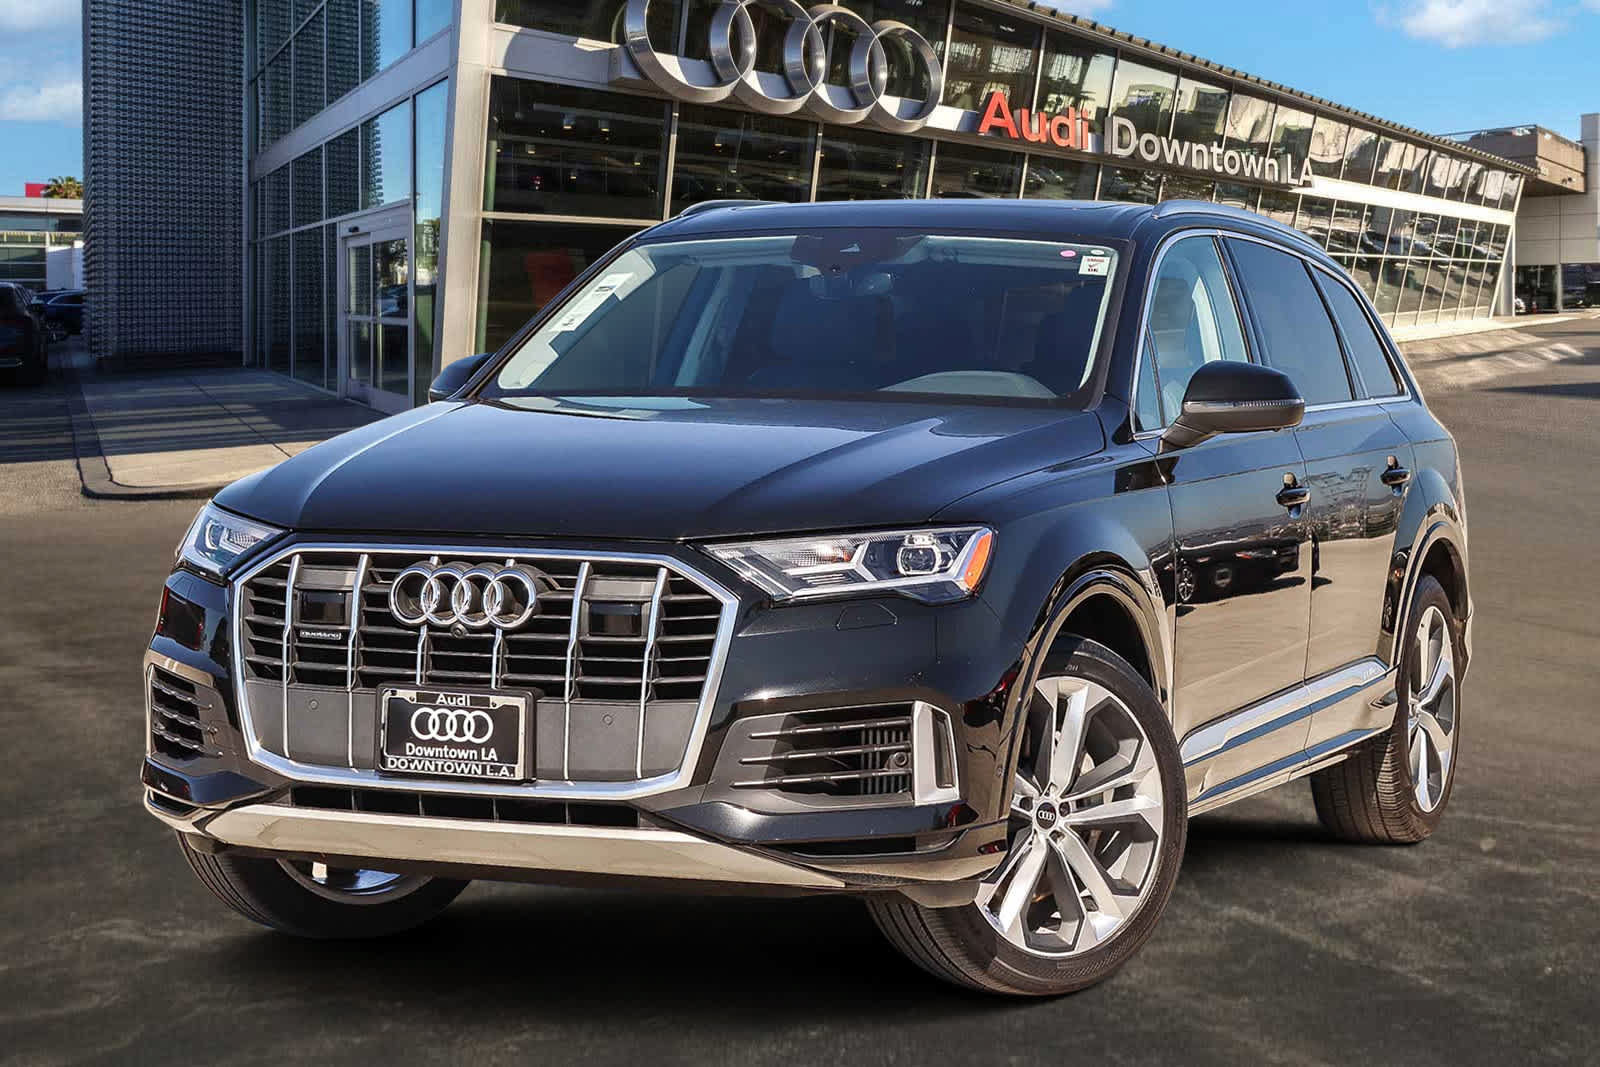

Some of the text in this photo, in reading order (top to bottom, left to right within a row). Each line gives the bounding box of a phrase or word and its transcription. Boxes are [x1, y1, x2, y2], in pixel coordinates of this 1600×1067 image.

[978, 91, 1314, 187] Audi Downtown LA
[436, 694, 471, 706] Audi
[405, 742, 498, 761] Downtown LA
[387, 757, 514, 777] DOWNTOWN L.A.
